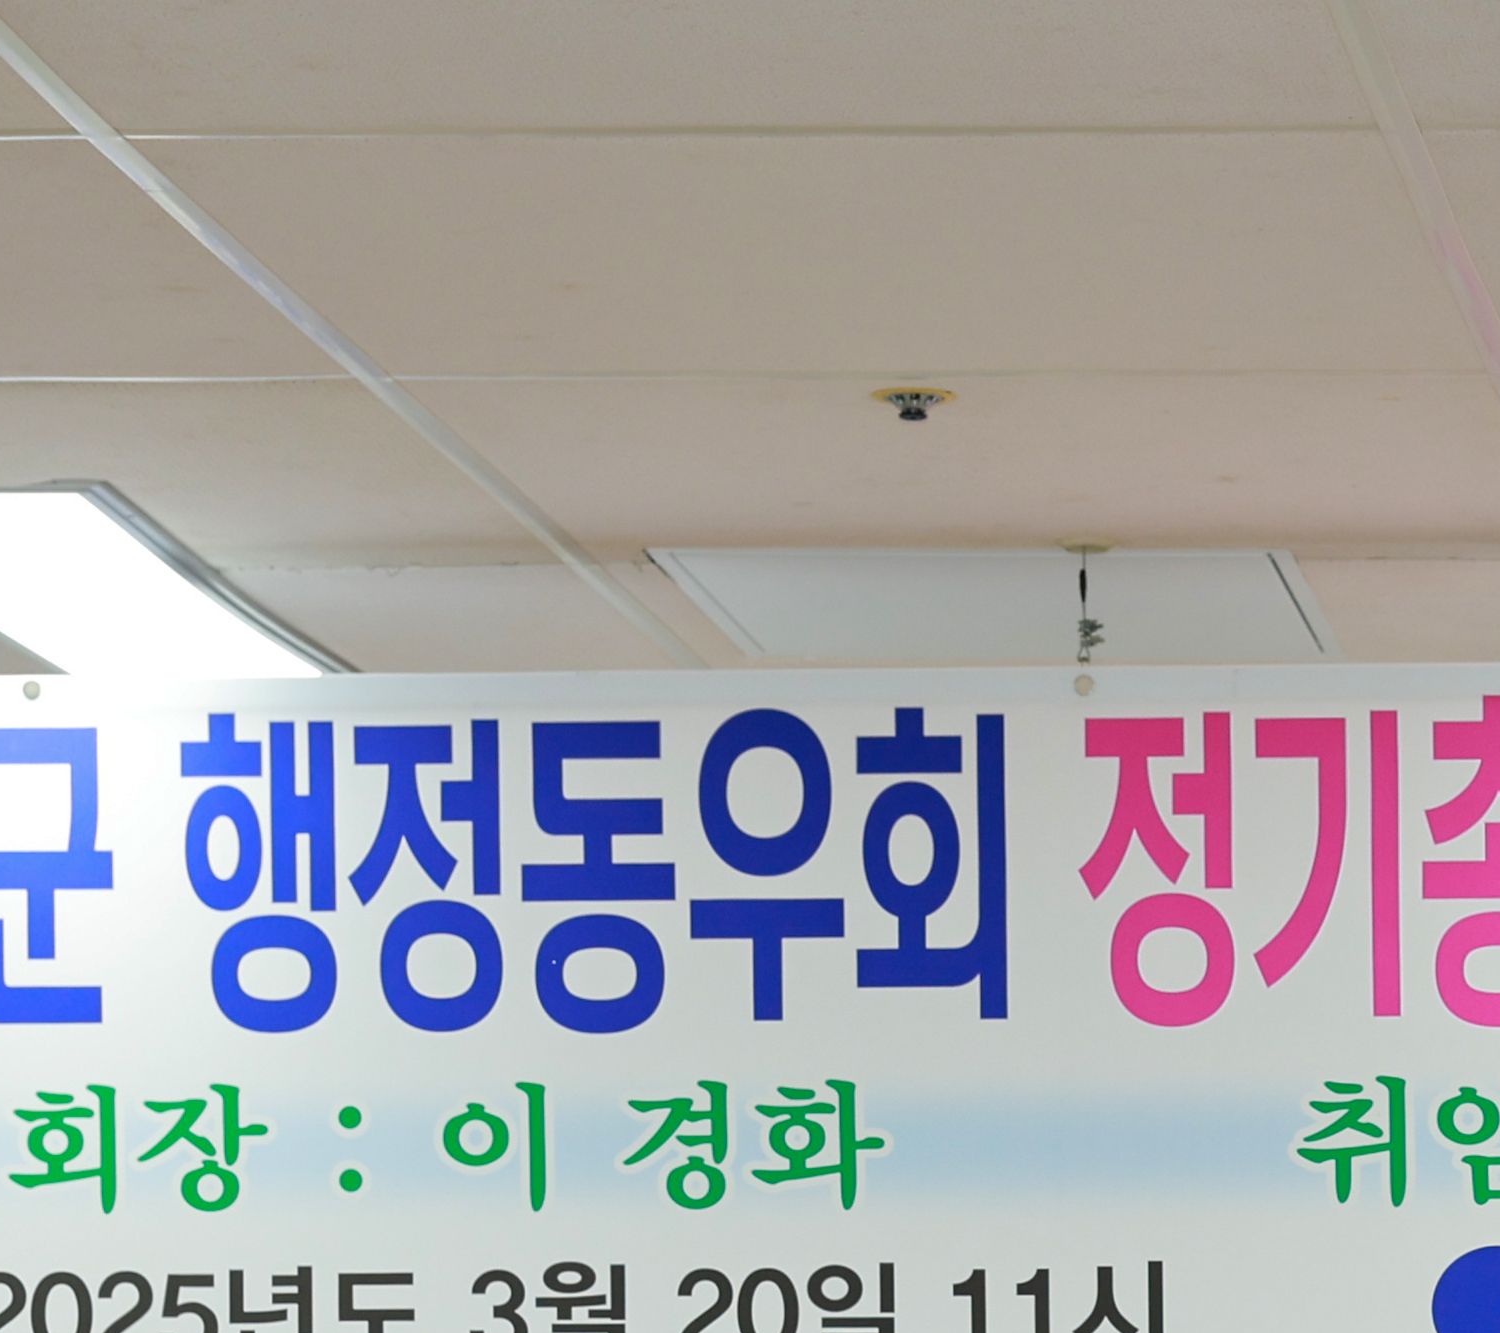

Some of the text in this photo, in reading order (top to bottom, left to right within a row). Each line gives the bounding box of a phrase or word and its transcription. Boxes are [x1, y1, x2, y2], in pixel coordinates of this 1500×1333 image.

[181, 709, 1006, 1033] 행정동우회
[444, 1082, 546, 1211] 이
[624, 1080, 884, 1210] 경화
